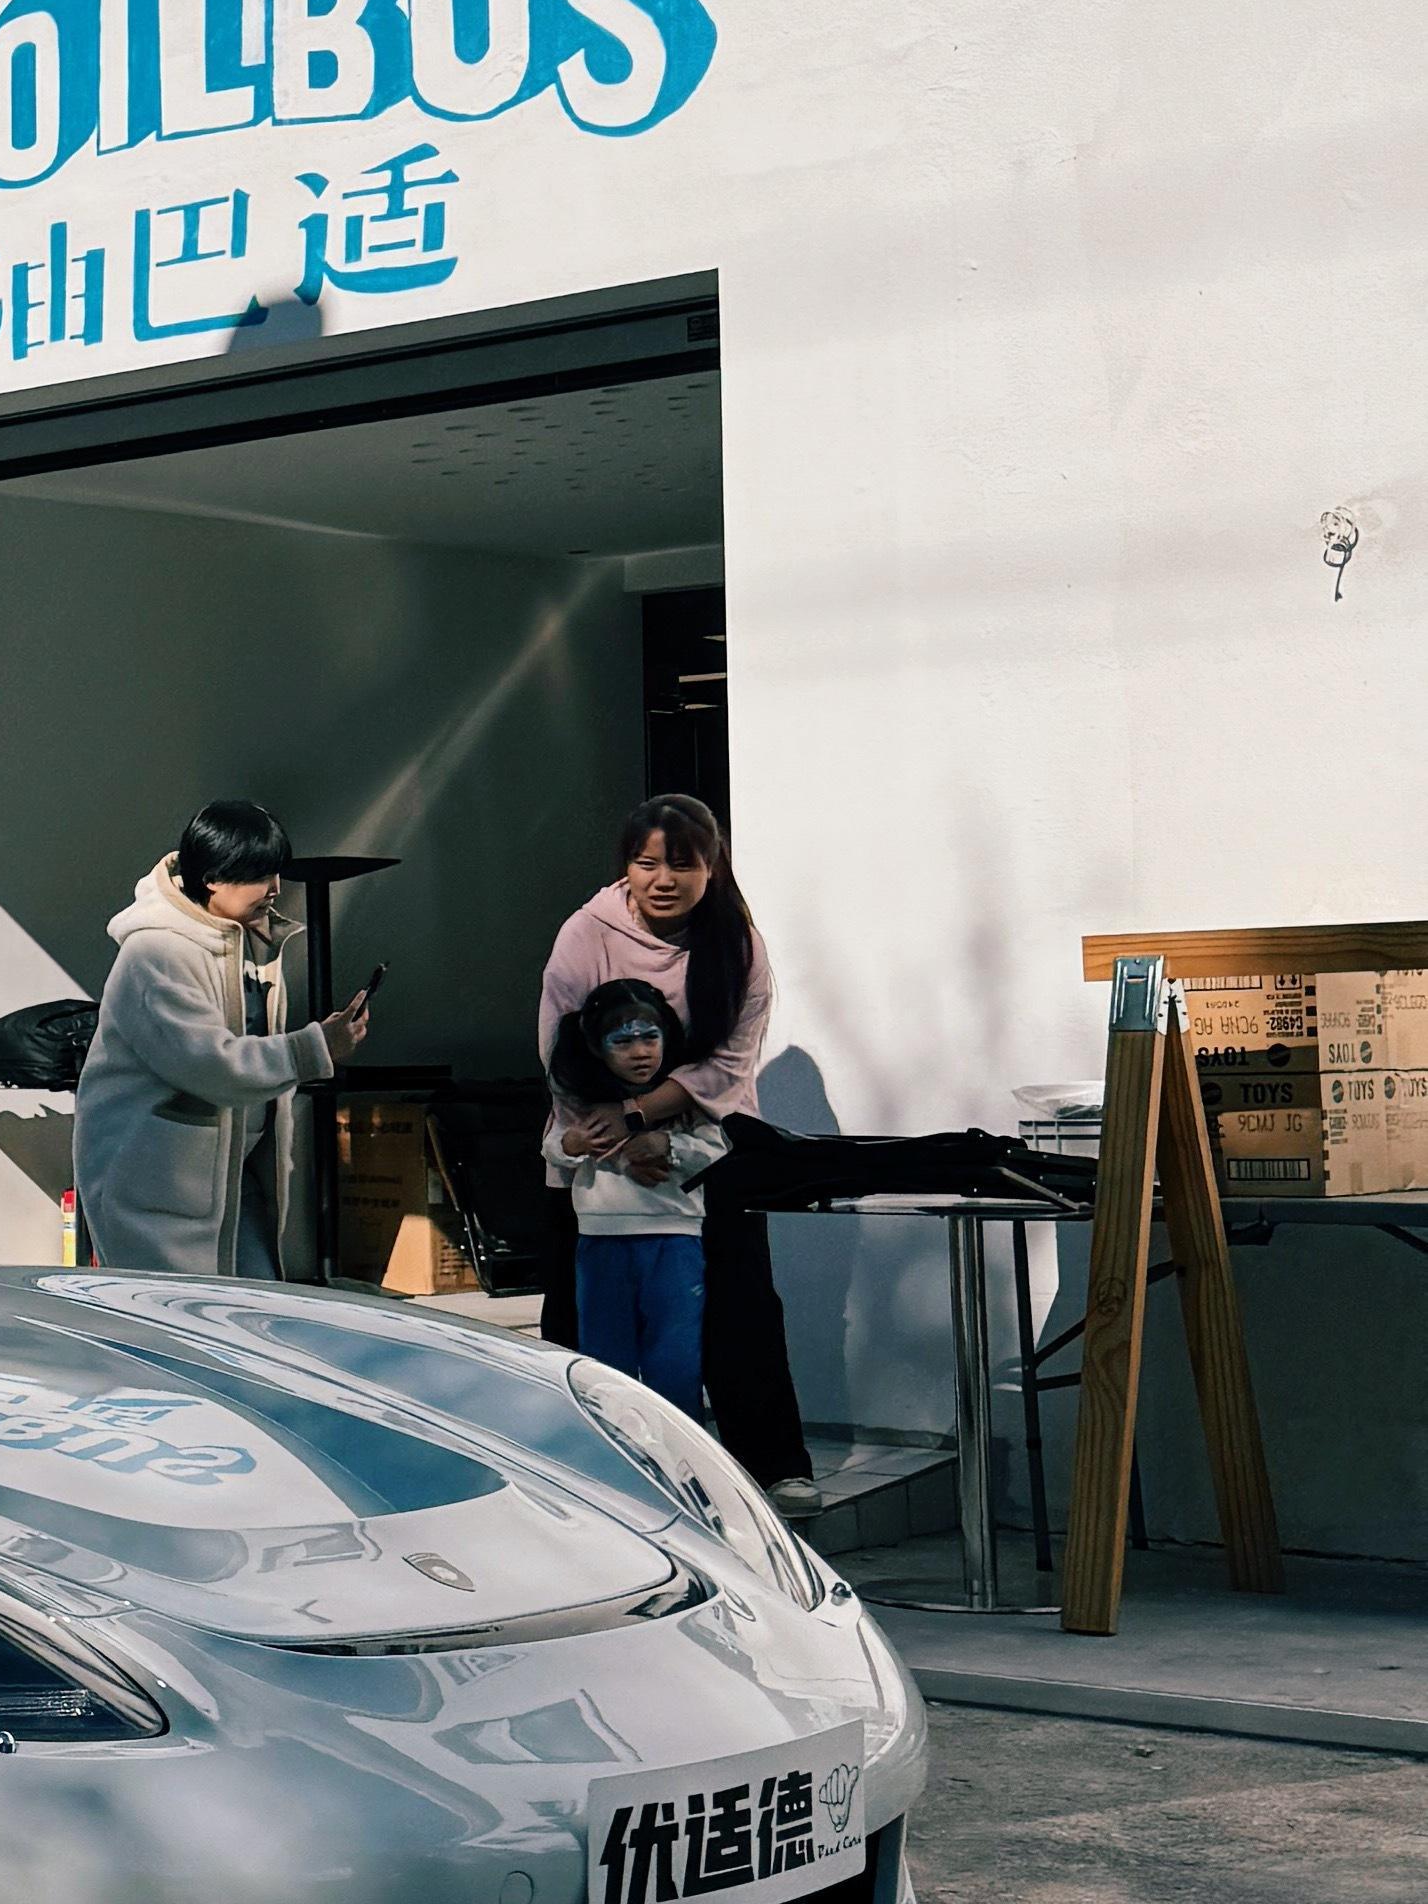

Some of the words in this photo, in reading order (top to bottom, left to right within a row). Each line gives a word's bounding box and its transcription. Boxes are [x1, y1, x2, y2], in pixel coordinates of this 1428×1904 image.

[1197, 1046, 1250, 1068] TOYS
[1329, 1043, 1356, 1064] TOYS
[1239, 1082, 1293, 1104] TOYS
[1348, 1078, 1374, 1100] TOYS
